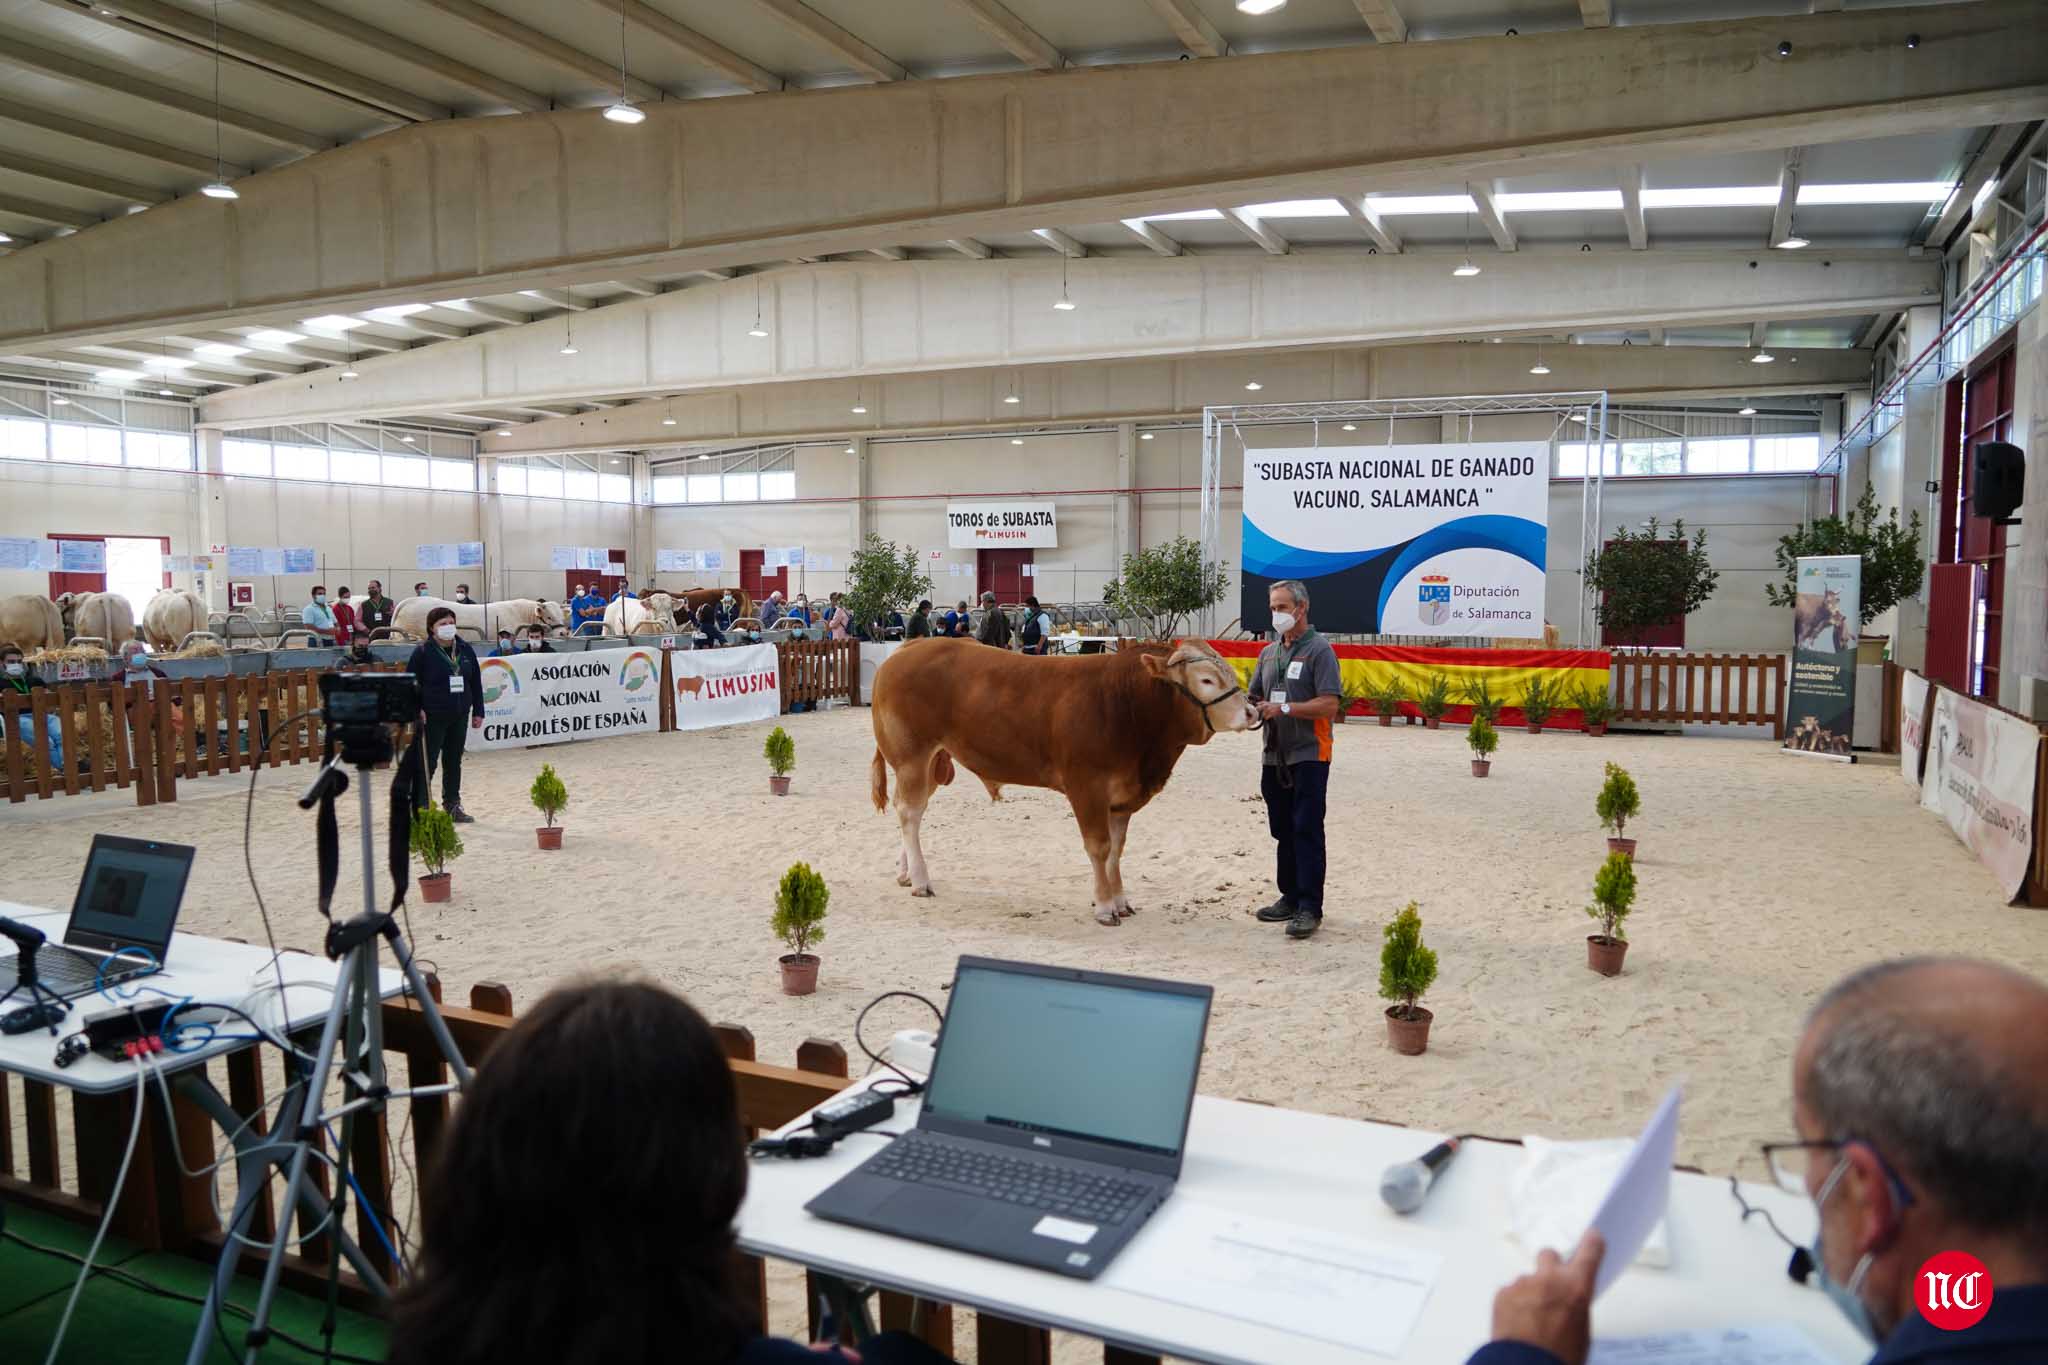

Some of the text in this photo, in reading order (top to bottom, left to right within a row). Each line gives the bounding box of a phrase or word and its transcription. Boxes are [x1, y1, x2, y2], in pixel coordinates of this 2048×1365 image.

[1254, 457, 1534, 481] "SUBASTA NACIONAL DE GANADO
[1371, 488, 1479, 508] SALAMANCA
[949, 511, 1054, 527] TOROS de SUBASTA
[988, 530, 1027, 539] LIMUSIN
[1453, 585, 1519, 600] Diputación
[1452, 607, 1532, 620] de Salamanca
[531, 660, 611, 681] ASOCIACIÓN
[706, 671, 776, 699] LIMUSIN
[540, 690, 602, 708] NACIONAL
[483, 707, 648, 741] CHAROLÉS DE ESPAÑA
